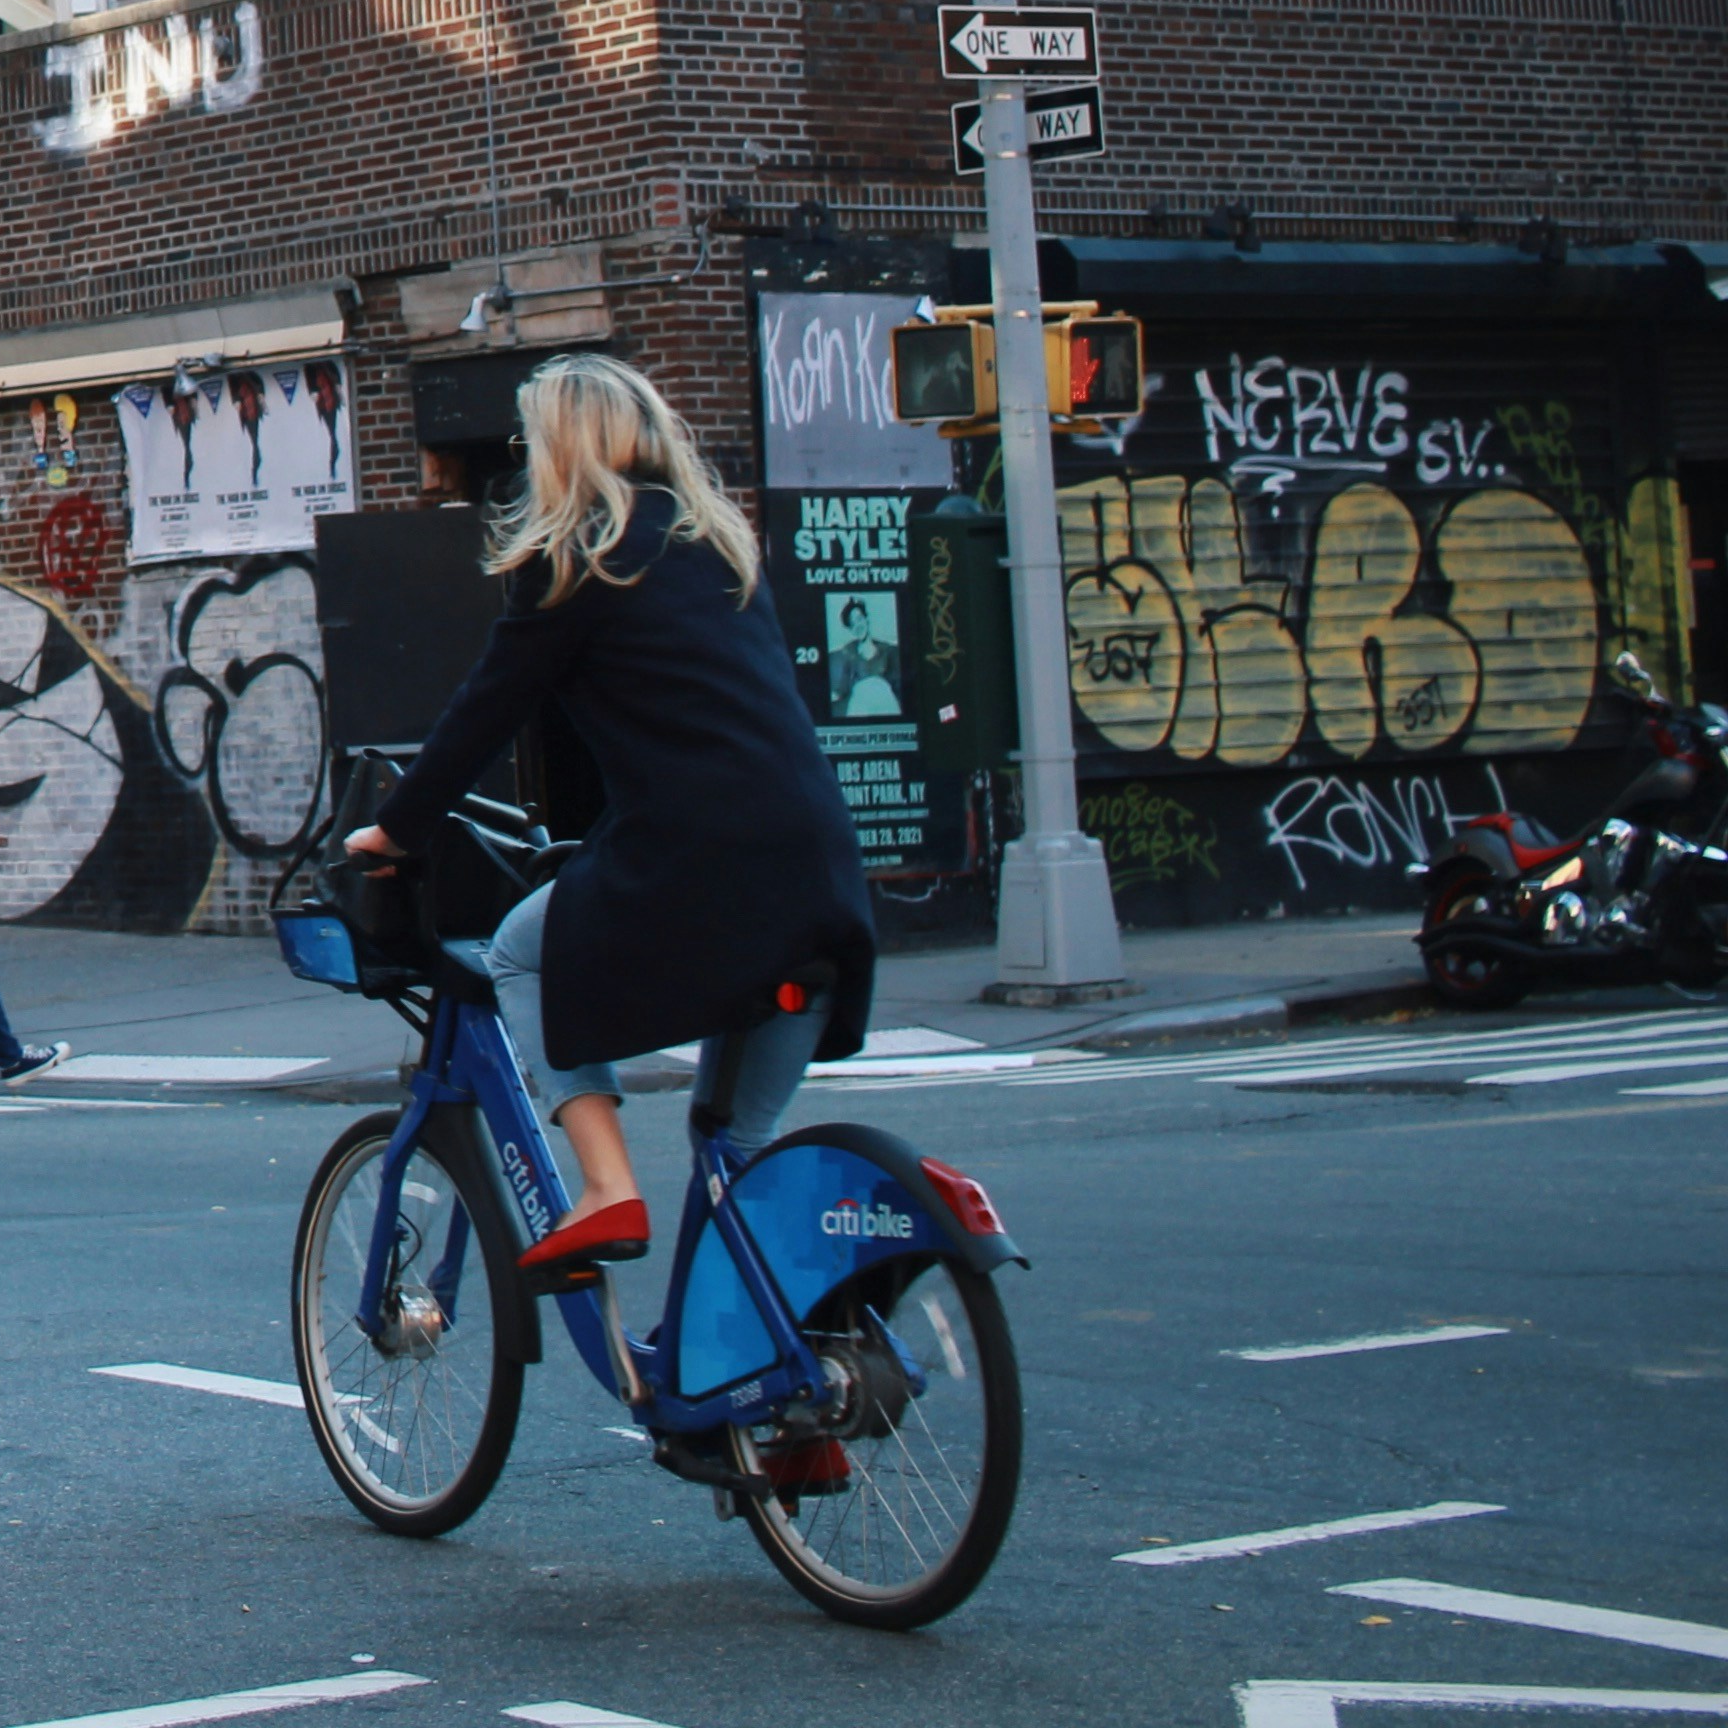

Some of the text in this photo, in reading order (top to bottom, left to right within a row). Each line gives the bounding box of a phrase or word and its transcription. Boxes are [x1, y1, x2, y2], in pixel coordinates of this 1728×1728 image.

[966, 31, 1074, 56] ONE WAY
[1036, 109, 1080, 139] WAY
[800, 497, 912, 528] HARRY
[806, 569, 844, 584] LOVE
[847, 568, 871, 584] ON
[795, 647, 819, 664] 20
[863, 759, 901, 781] ARENA
[909, 782, 926, 803] NY
[897, 827, 923, 845] 2021
[521, 1186, 550, 1242] bik
[861, 1203, 913, 1239] bike
